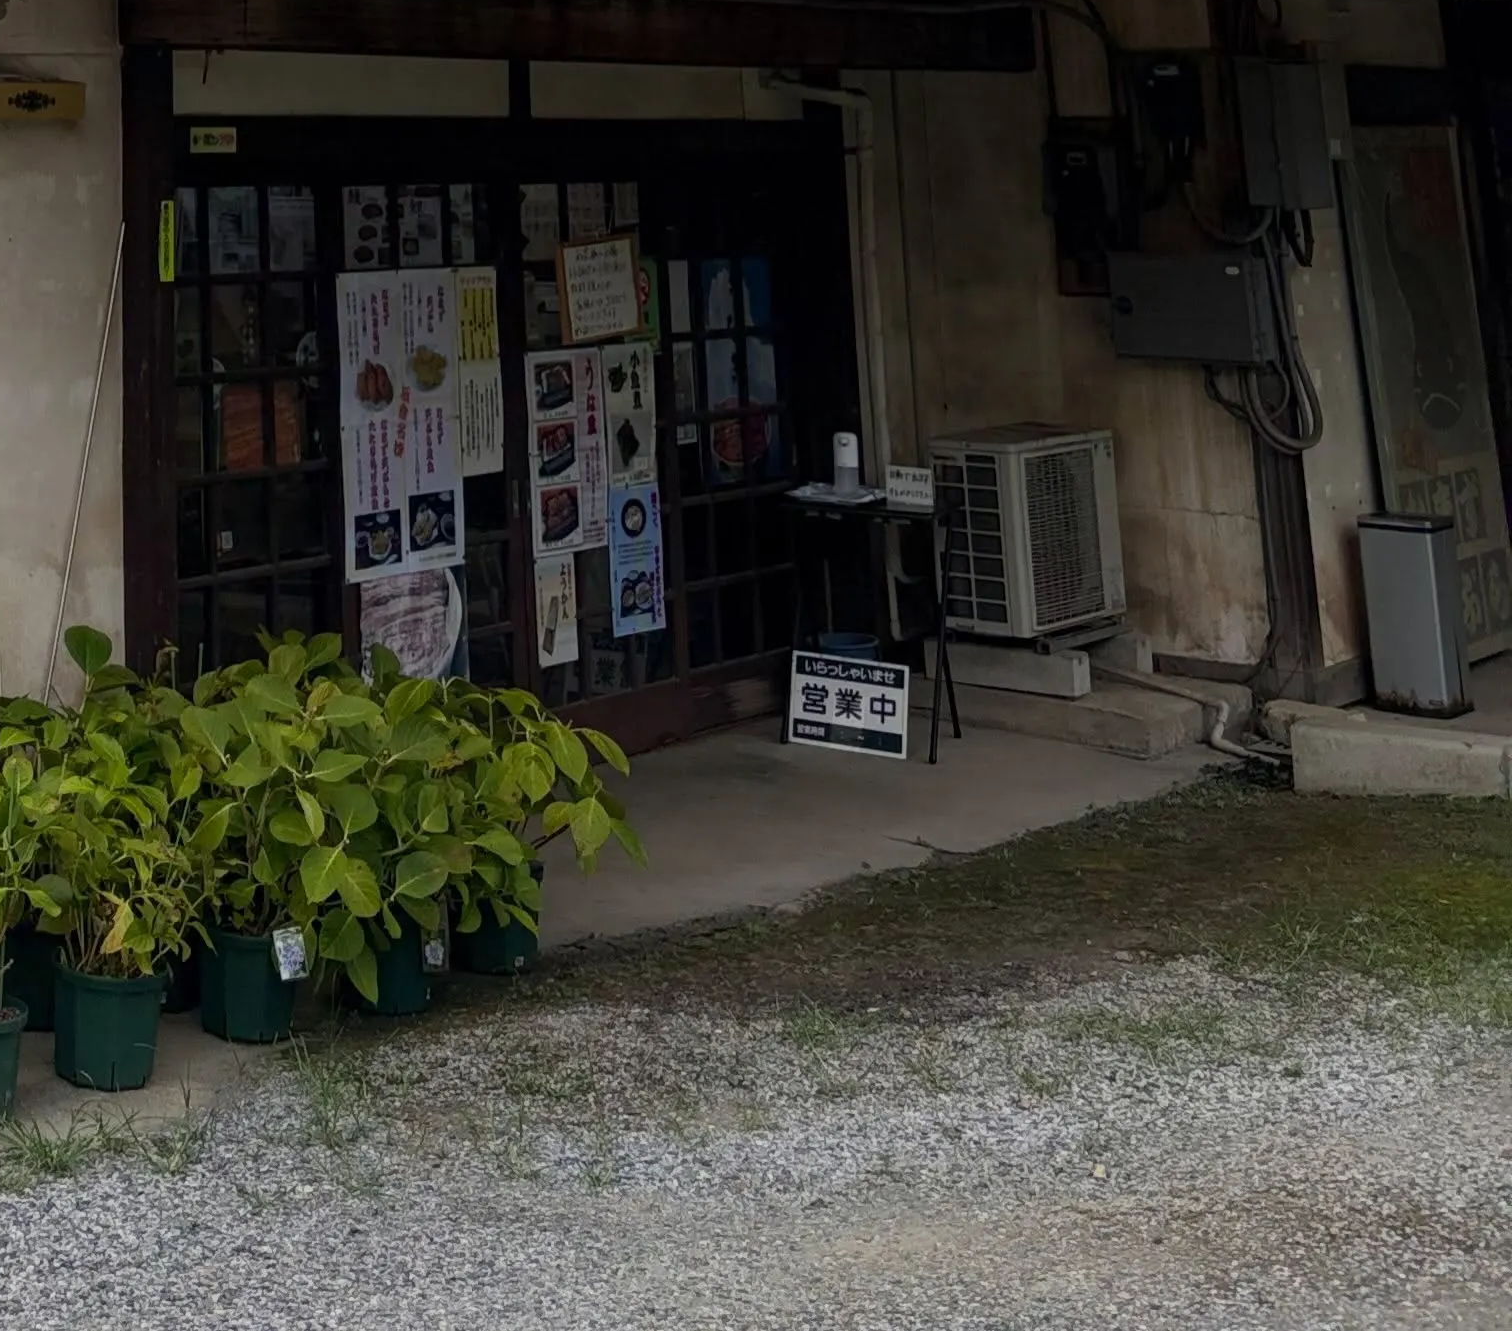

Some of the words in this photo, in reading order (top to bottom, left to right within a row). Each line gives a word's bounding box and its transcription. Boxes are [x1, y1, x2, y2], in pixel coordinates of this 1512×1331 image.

[804, 659, 896, 684] いらっしゃいませ
[801, 682, 896, 725] 営業中
